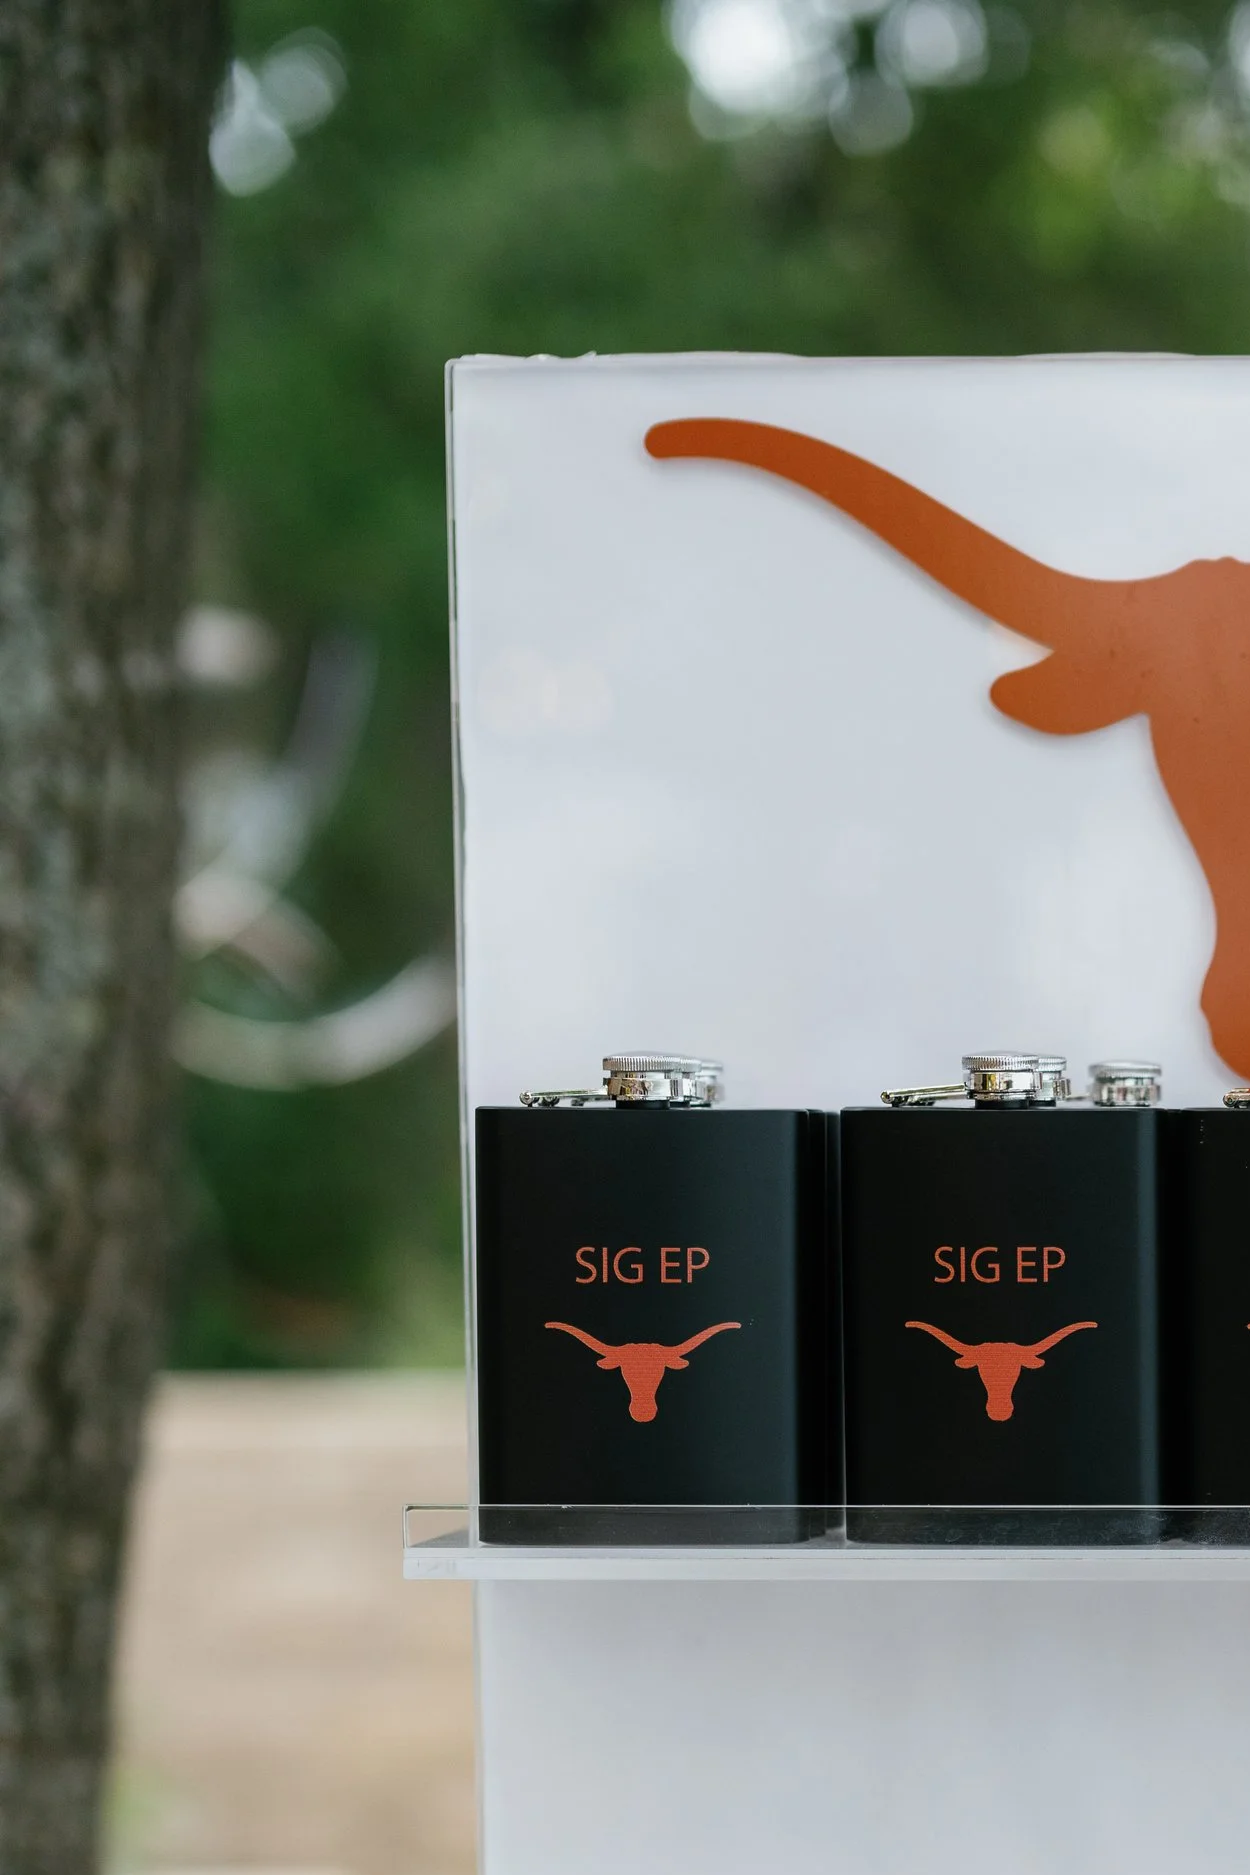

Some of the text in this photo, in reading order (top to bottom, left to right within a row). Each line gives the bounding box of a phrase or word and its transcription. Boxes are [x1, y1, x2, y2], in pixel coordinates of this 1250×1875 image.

[575, 1246, 710, 1285] SIG EP
[933, 1244, 1067, 1284] SIG EP
